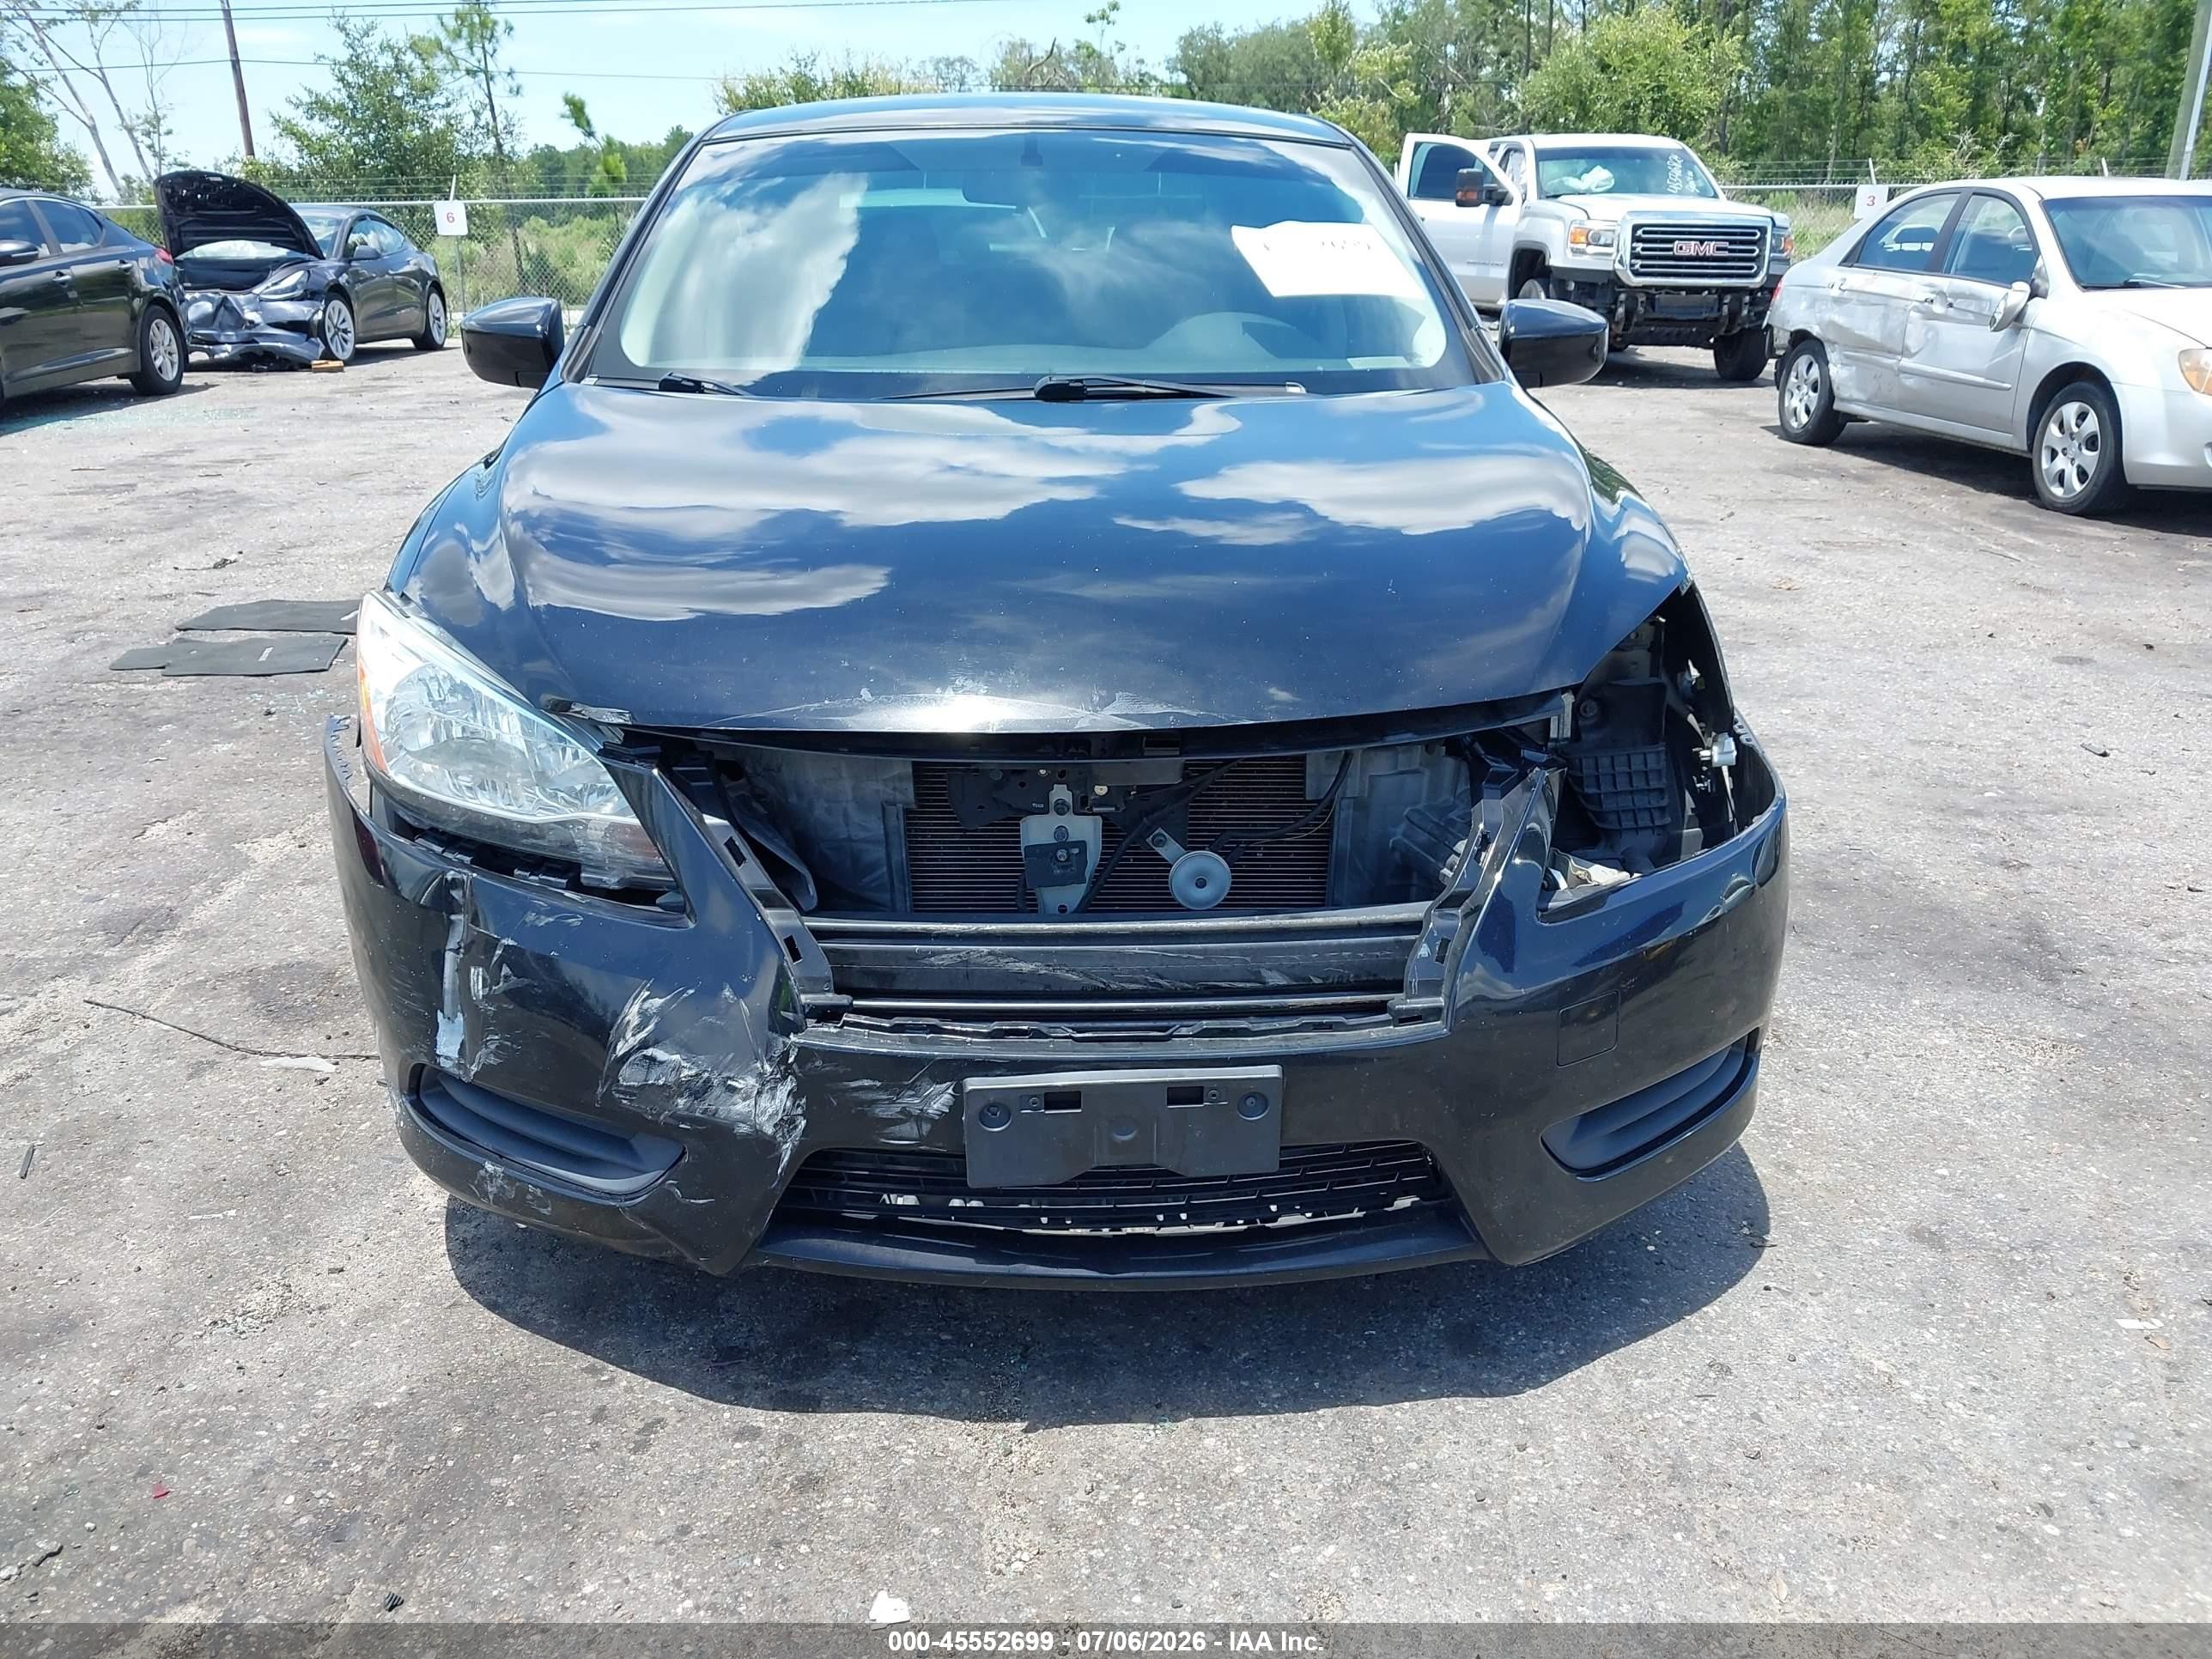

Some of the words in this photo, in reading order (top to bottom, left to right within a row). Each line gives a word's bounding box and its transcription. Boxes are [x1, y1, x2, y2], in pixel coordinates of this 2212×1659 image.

[1867, 195, 1876, 207] 3
[446, 211, 455, 223] 6
[1674, 240, 1729, 256] GMC
